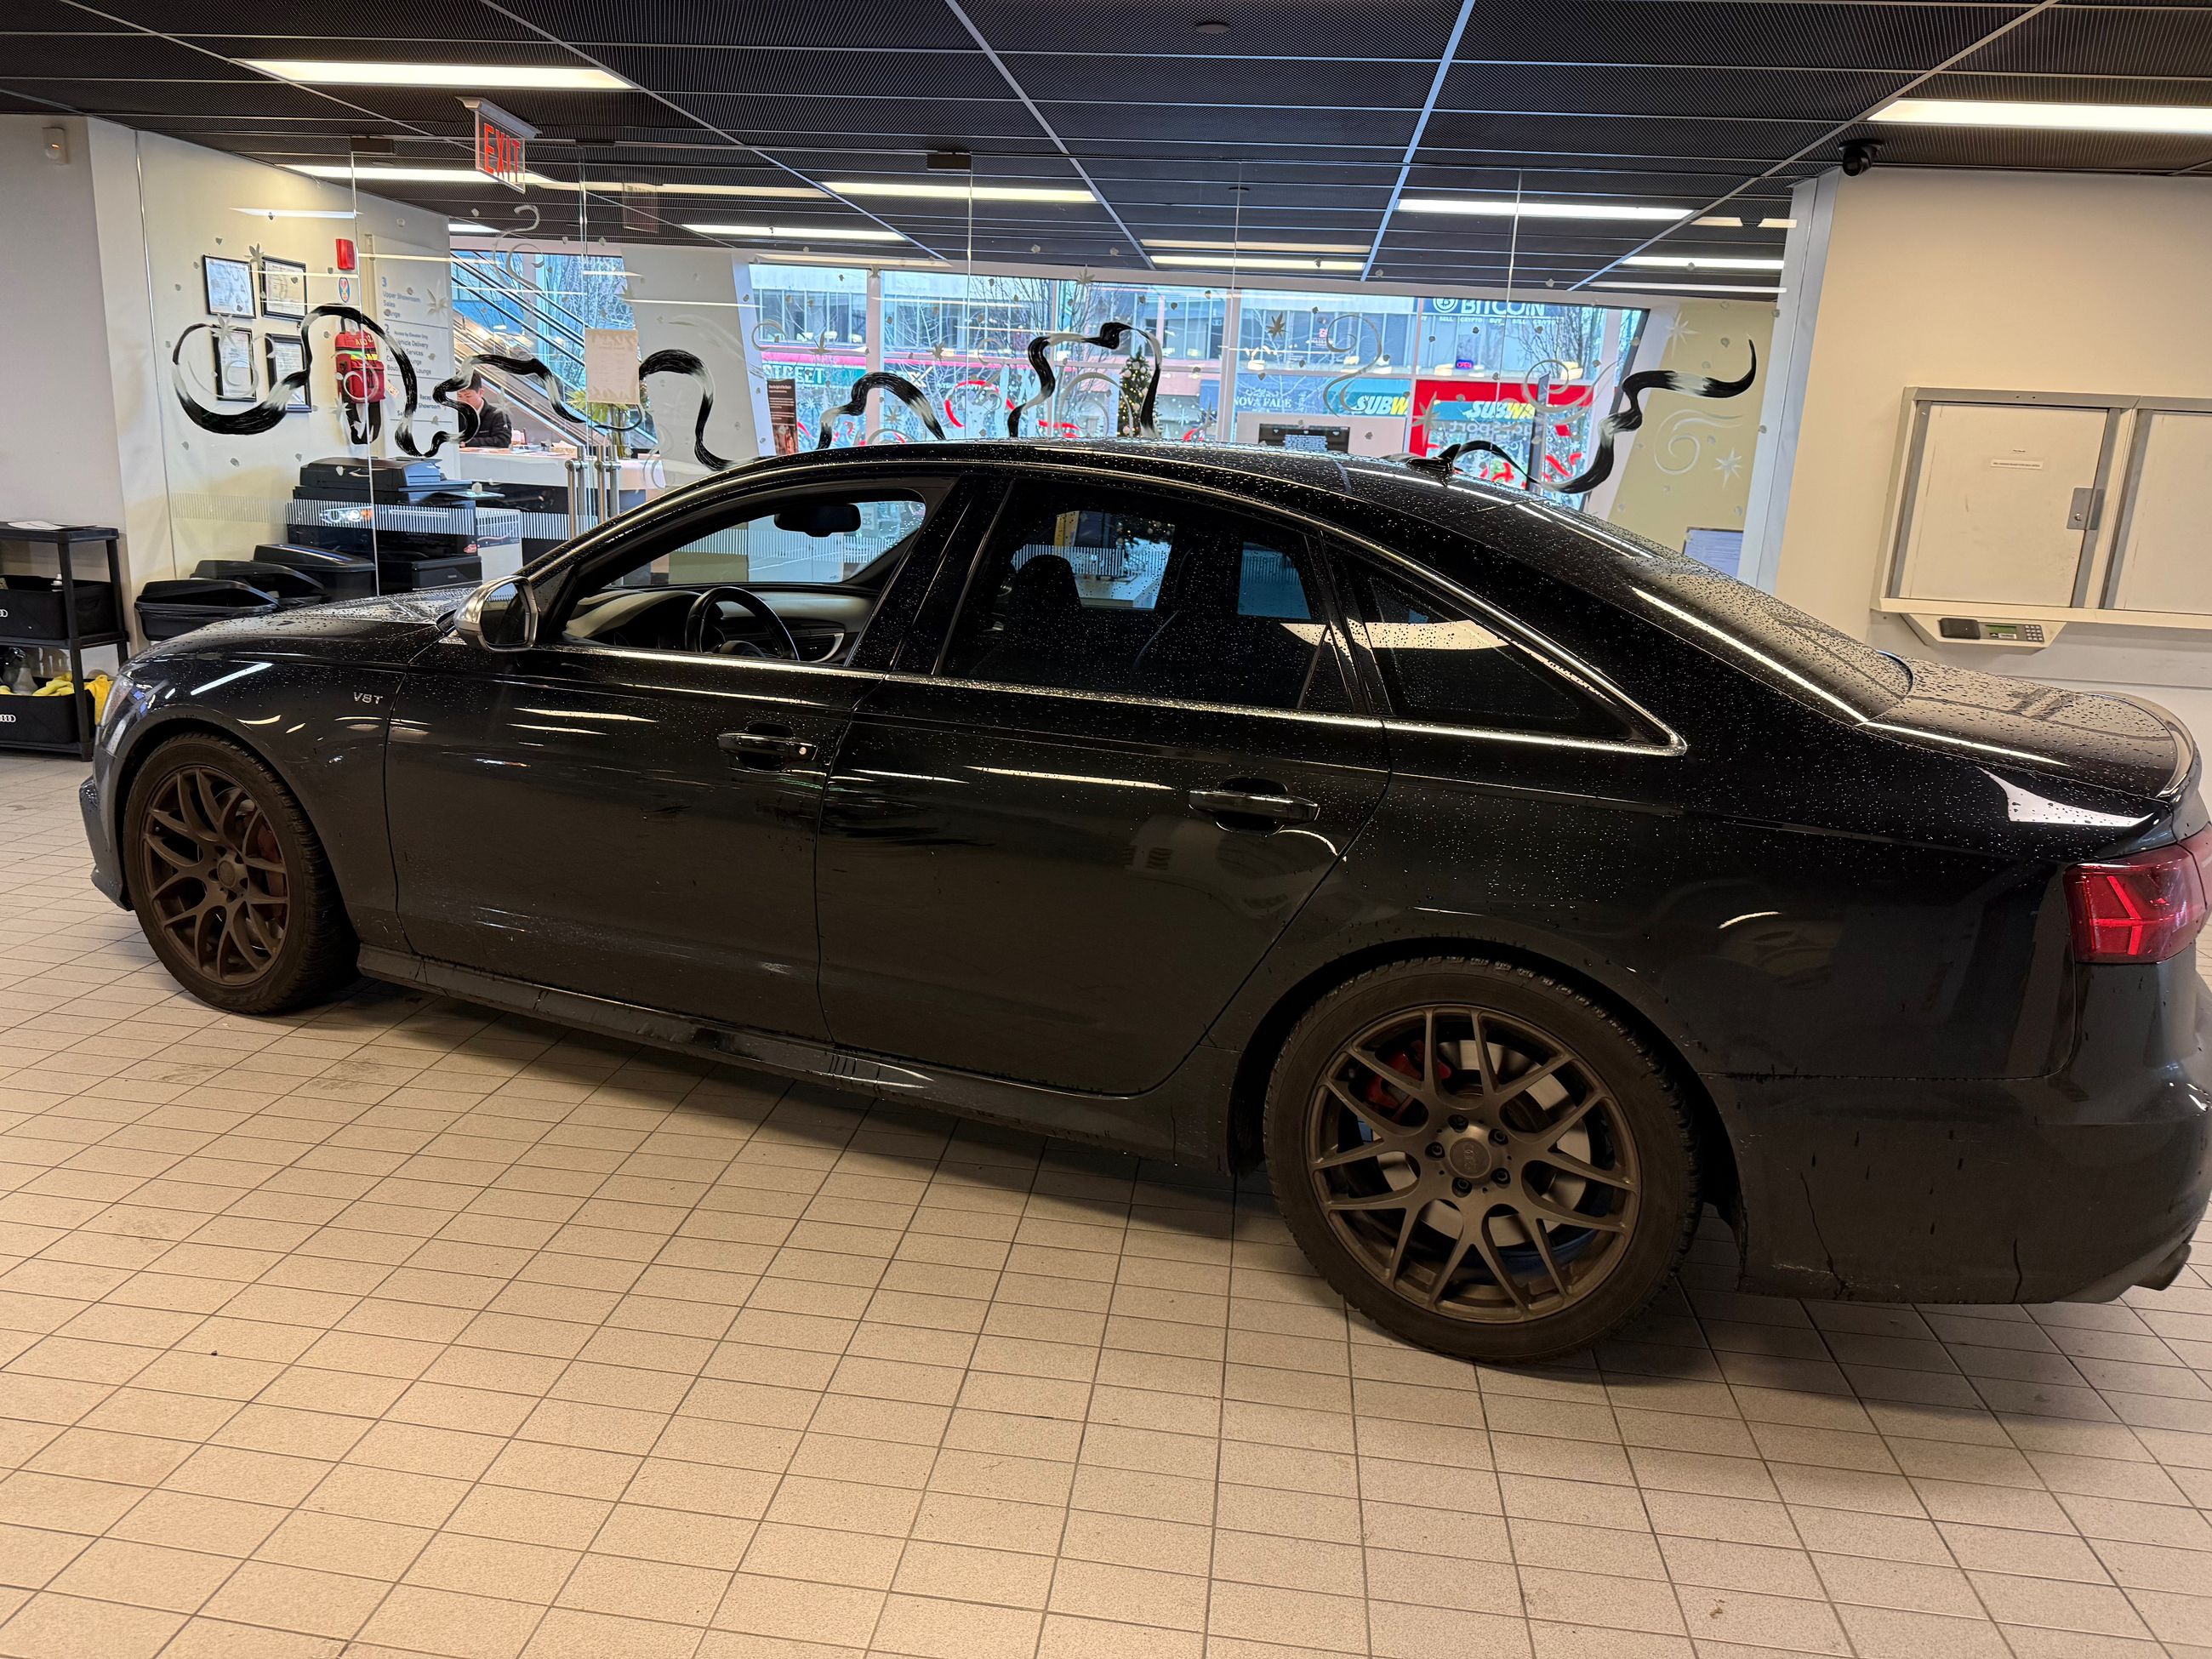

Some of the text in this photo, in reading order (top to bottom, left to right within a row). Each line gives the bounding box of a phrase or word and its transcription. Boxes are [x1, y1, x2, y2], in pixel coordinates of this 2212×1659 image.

[484, 123, 521, 184] EXIT
[1461, 299, 1545, 316] BITCOIN
[385, 323, 390, 334] 2
[762, 364, 824, 384] STREET
[1350, 395, 1409, 415] SUBW
[1462, 401, 1536, 420] SUBWA
[353, 692, 384, 704] V8T
